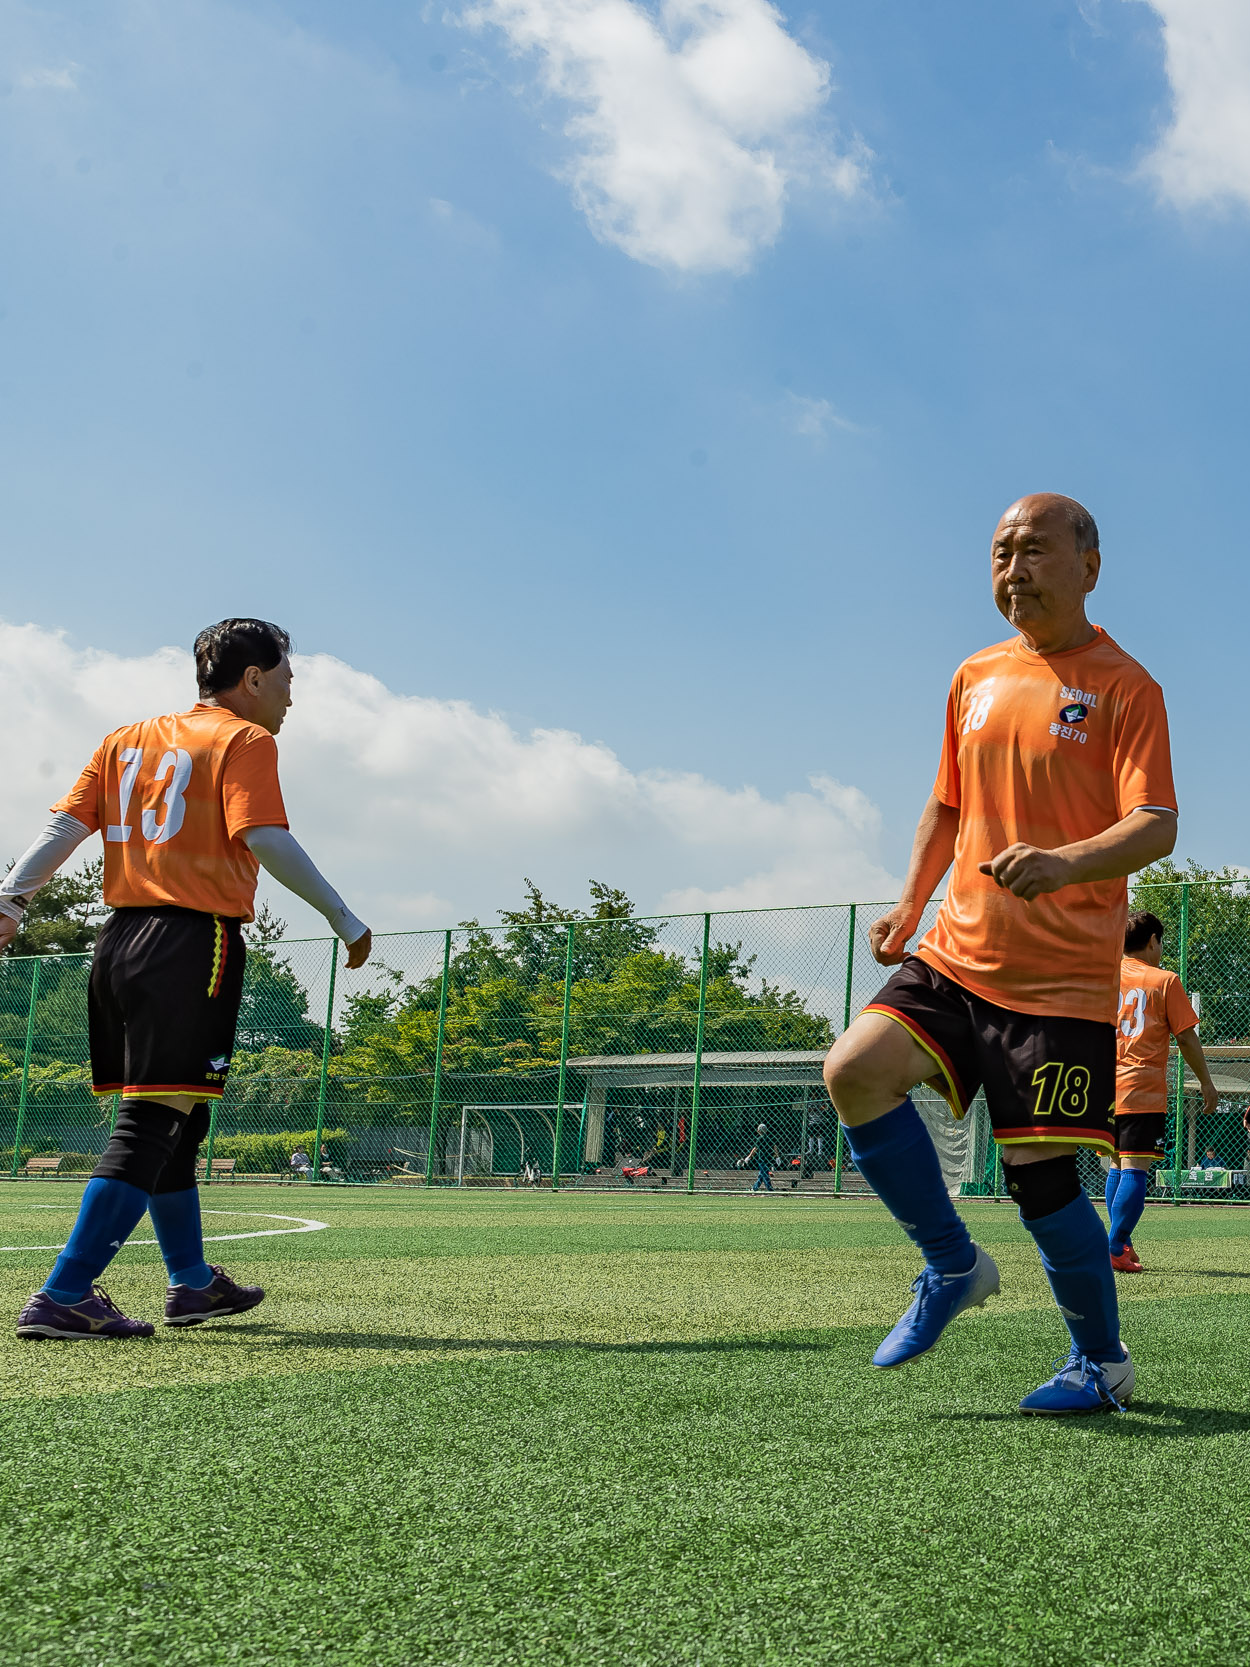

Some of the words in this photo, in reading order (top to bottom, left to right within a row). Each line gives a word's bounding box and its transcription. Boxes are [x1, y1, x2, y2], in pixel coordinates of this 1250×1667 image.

[962, 694, 994, 736] 18
[1060, 686, 1097, 708] SEOUL
[1048, 722, 1088, 745] 광진70
[105, 747, 193, 845] 13
[1117, 987, 1148, 1039] 3
[1031, 1061, 1091, 1117] 18
